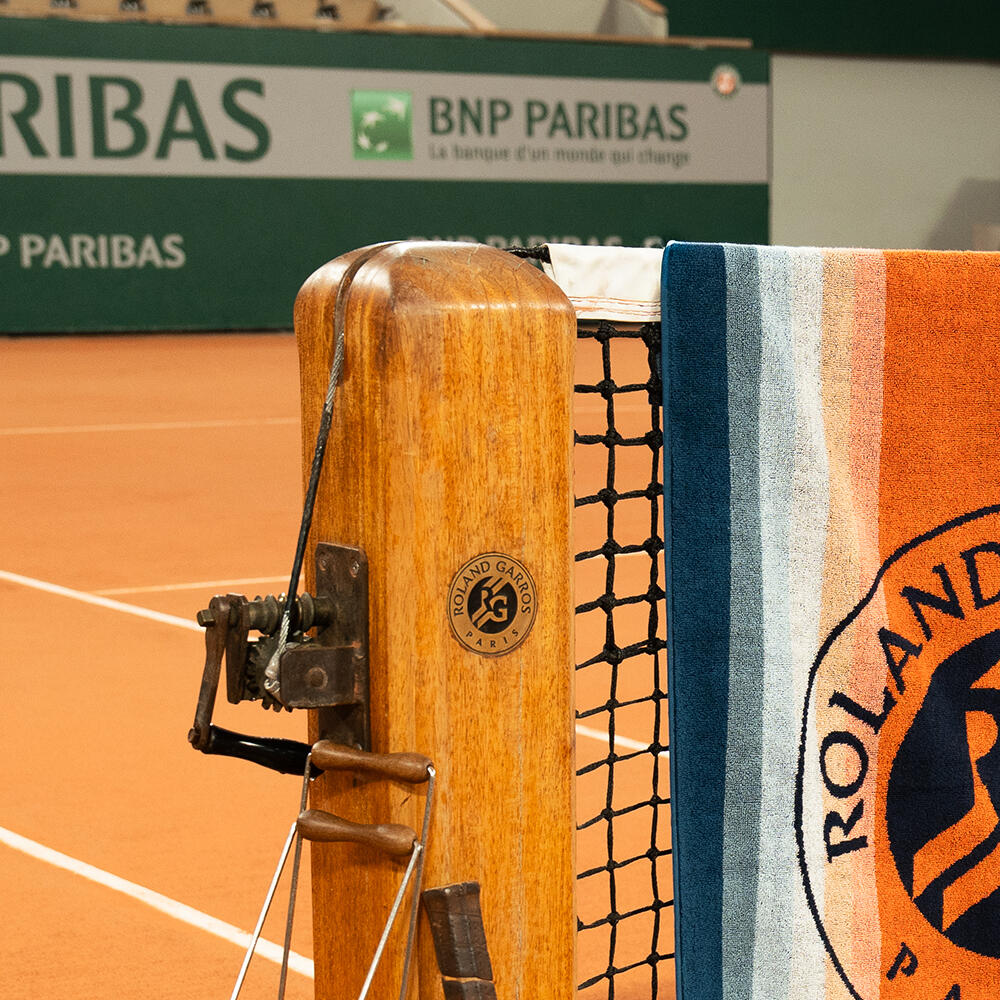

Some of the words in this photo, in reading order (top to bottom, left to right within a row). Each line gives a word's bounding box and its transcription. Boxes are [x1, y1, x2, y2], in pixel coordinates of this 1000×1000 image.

[0, 73, 271, 163] RIBAS
[430, 97, 512, 135] BNP
[525, 100, 689, 141] PARIBAS
[20, 233, 187, 268] PARIBAS
[454, 561, 491, 616] ROLAND
[496, 561, 532, 614] GARROS
[466, 629, 519, 647] PARIS
